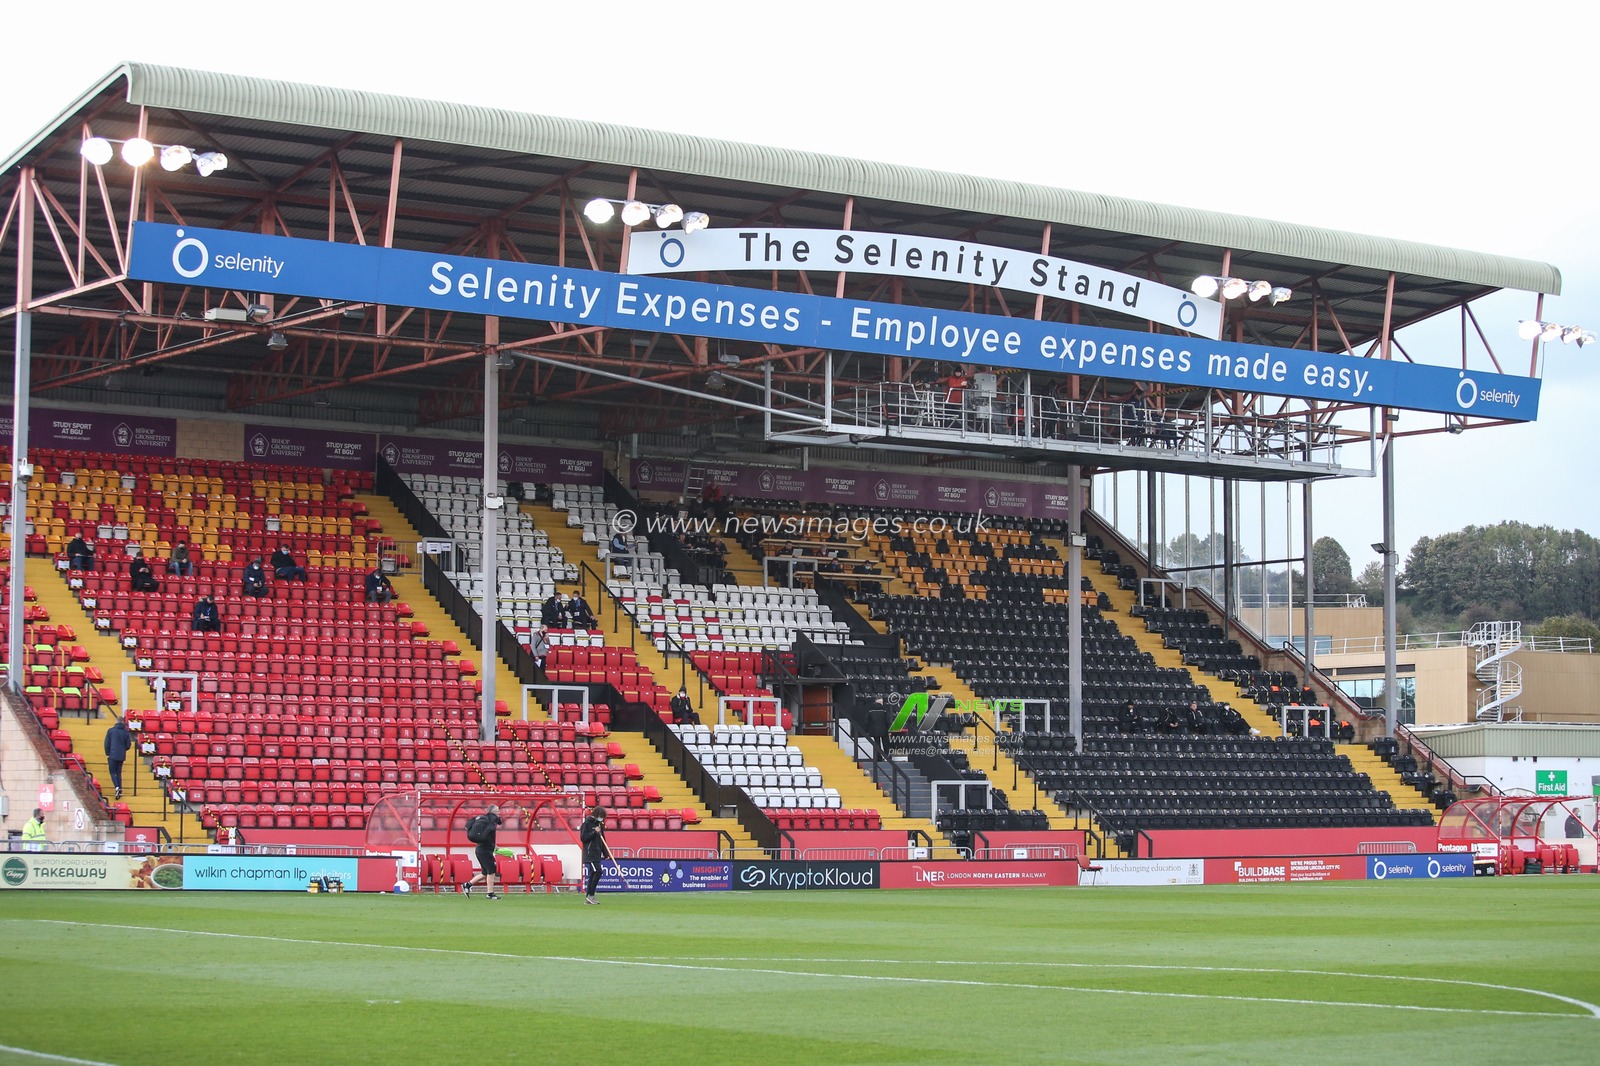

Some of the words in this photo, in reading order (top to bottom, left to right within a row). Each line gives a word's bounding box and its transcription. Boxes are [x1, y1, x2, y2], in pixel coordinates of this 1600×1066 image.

[215, 253, 284, 278] selenity
[739, 232, 810, 263] The
[835, 234, 1008, 286] Selenity
[1030, 258, 1141, 308] Stand
[429, 261, 601, 319] Selenity
[617, 282, 799, 326] Expenses
[851, 307, 1021, 357] Employee
[1040, 335, 1191, 372] expenses
[1207, 353, 1287, 383] made
[1303, 363, 1374, 397] easy.
[1480, 389, 1520, 408] selenity
[72, 422, 92, 430] SPORT
[1538, 783, 1553, 791] First
[1554, 783, 1565, 791] Aid
[1438, 843, 1468, 852] Pentagon
[692, 866, 722, 874] INSIGHT
[1110, 864, 1150, 873] life-changing
[1151, 863, 1181, 872] education
[1238, 867, 1285, 877] BUILDBASE
[1388, 865, 1413, 875] selenity
[1442, 864, 1466, 874] selenity
[33, 868, 107, 879] TAKEAWAY
[195, 866, 226, 879] wilkin
[231, 867, 291, 881] chapman
[294, 867, 308, 881] llp
[311, 868, 352, 880] solicitors
[769, 867, 873, 889] KryptoKloud
[916, 869, 944, 882] LNER
